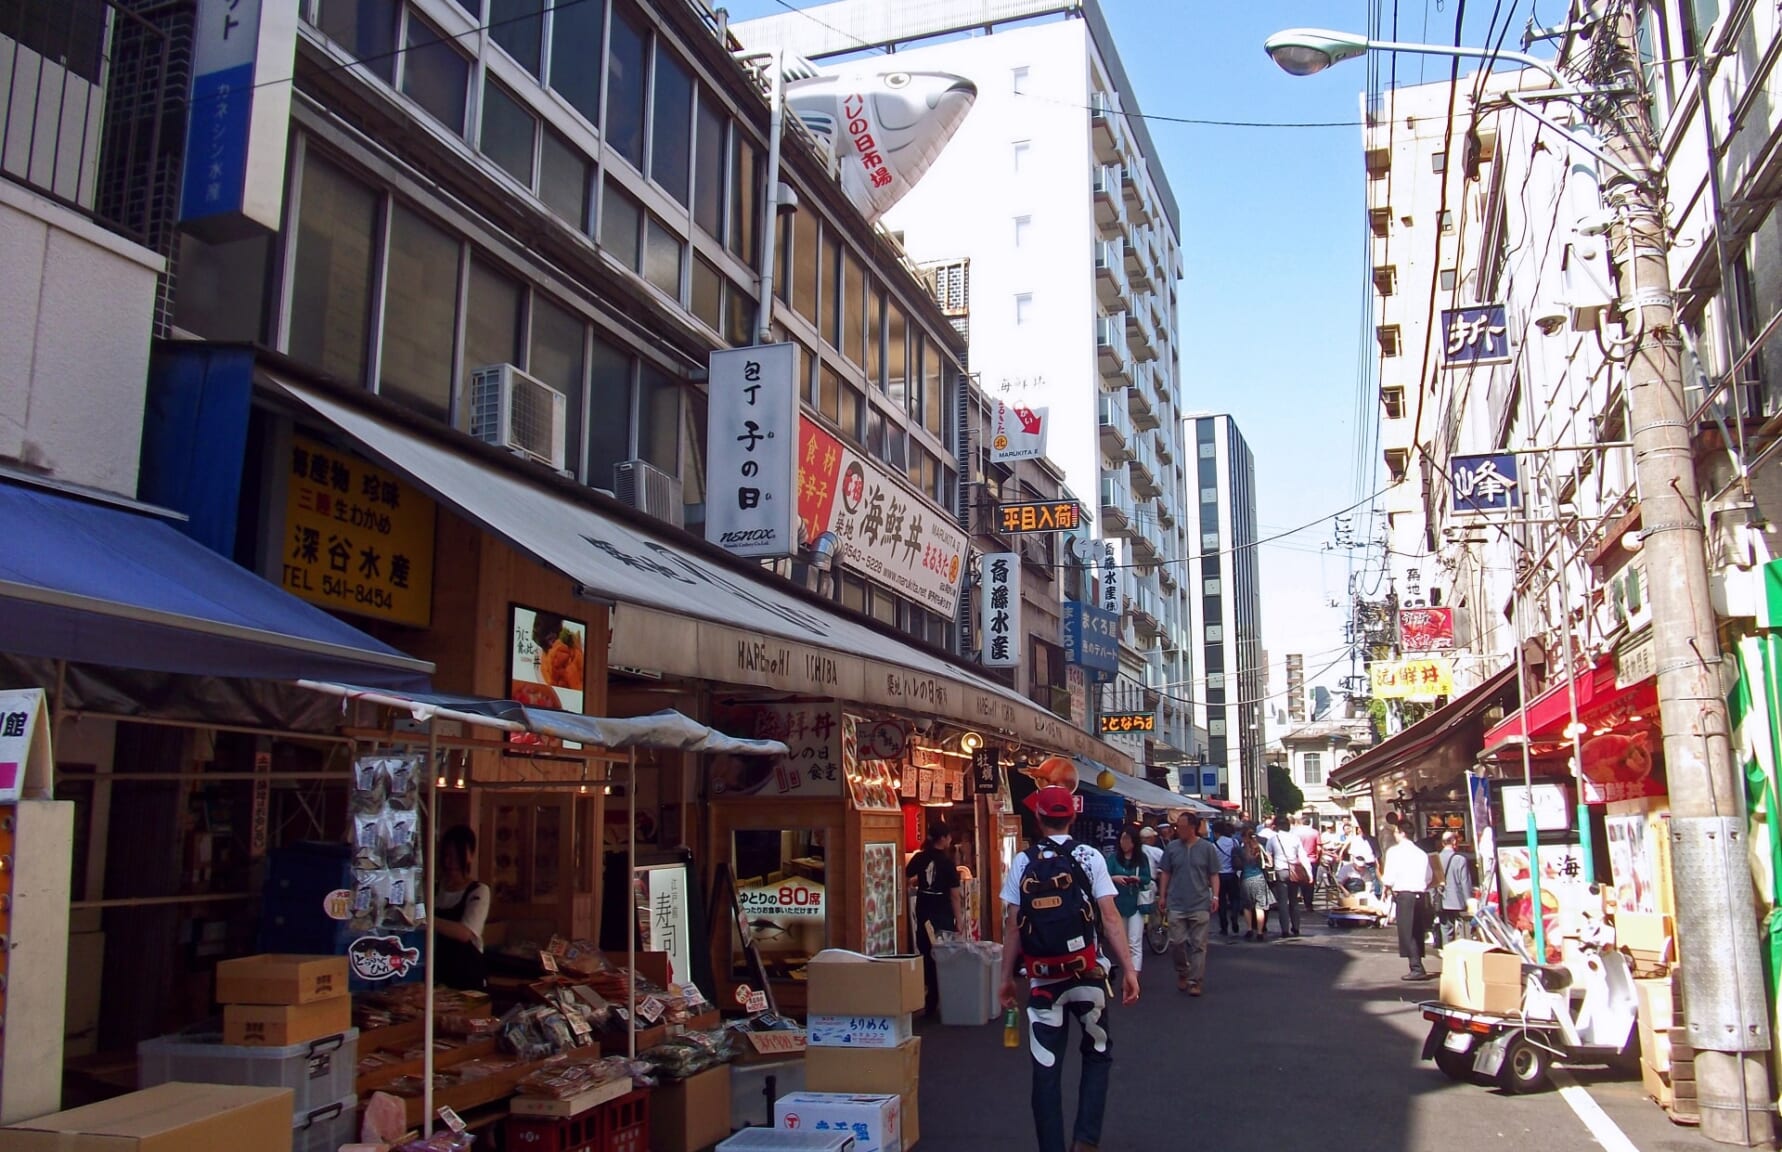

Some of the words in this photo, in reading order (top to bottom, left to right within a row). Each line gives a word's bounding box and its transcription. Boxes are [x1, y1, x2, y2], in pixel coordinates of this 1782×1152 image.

[843, 92, 893, 189] ハレの日市場
[1453, 459, 1518, 503] 峰
[859, 483, 923, 570] 海鮮丼
[292, 524, 411, 589] 深谷水産
[0, 710, 28, 738] 館
[783, 746, 830, 761] レの日
[656, 891, 677, 957] 寿司
[745, 906, 820, 915] ったりお食事いただけます
[850, 1017, 889, 1031] ちりめん
